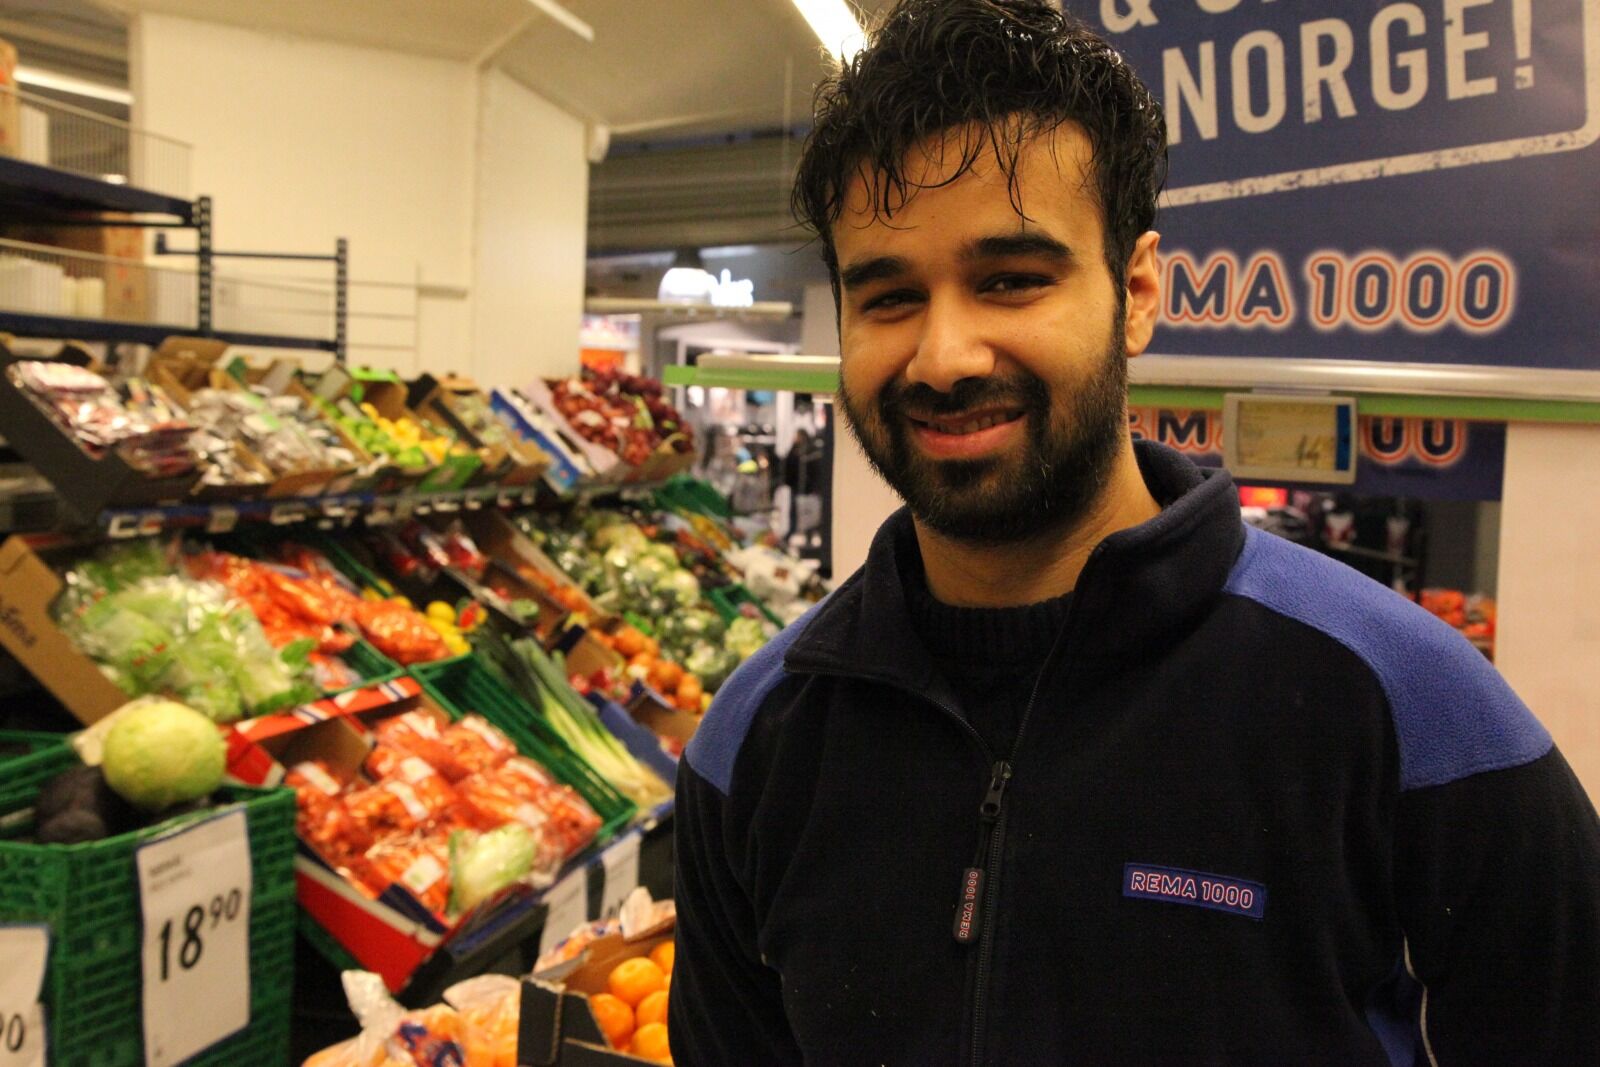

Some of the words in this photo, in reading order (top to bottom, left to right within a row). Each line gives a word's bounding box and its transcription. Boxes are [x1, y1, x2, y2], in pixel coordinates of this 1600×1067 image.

[1162, 0, 1535, 145] NORGE!
[1157, 251, 1296, 328] MA
[1305, 250, 1518, 331] 1000
[965, 871, 979, 900] 1000
[1131, 871, 1197, 899] REMA
[1202, 881, 1254, 909] 1000
[959, 902, 974, 939] REMA
